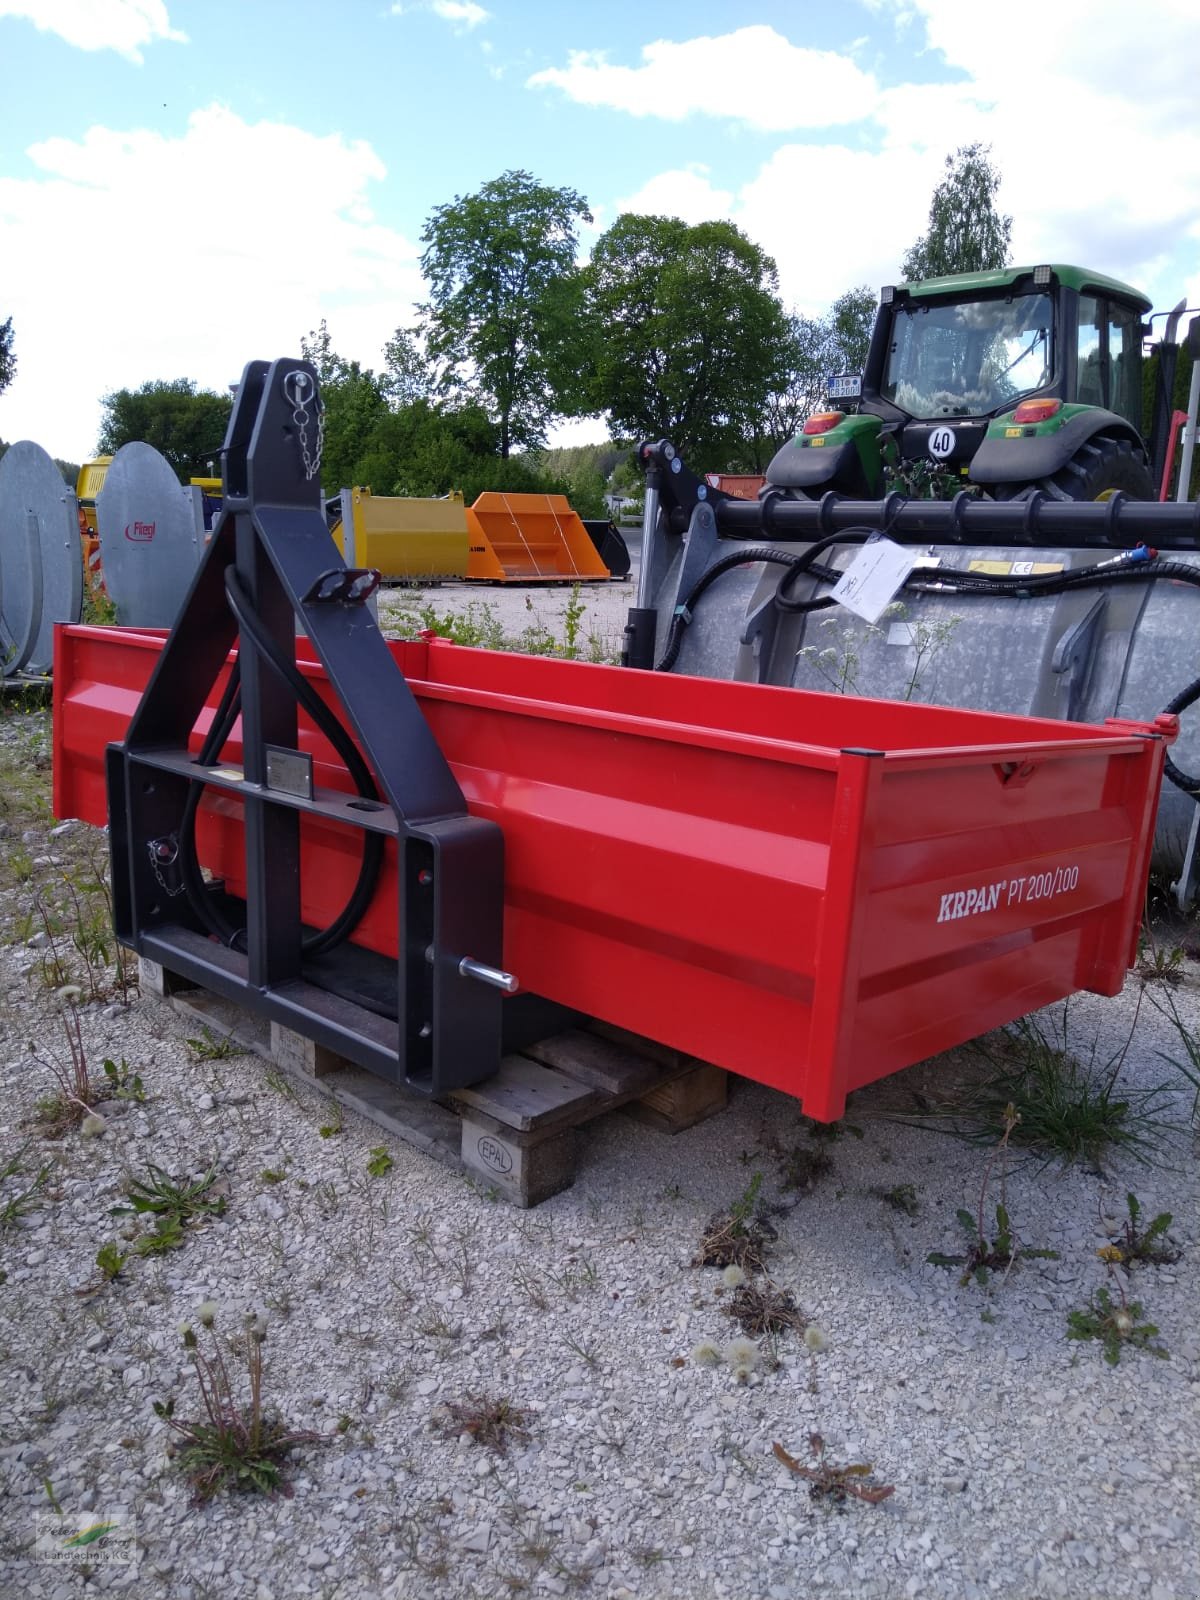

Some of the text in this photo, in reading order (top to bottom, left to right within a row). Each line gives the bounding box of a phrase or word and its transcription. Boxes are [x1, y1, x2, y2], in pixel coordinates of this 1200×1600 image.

[933, 432, 950, 452] 40
[1007, 877, 1027, 906] PT
[1026, 865, 1079, 901] 200/100
[482, 1141, 507, 1169] EPAL
